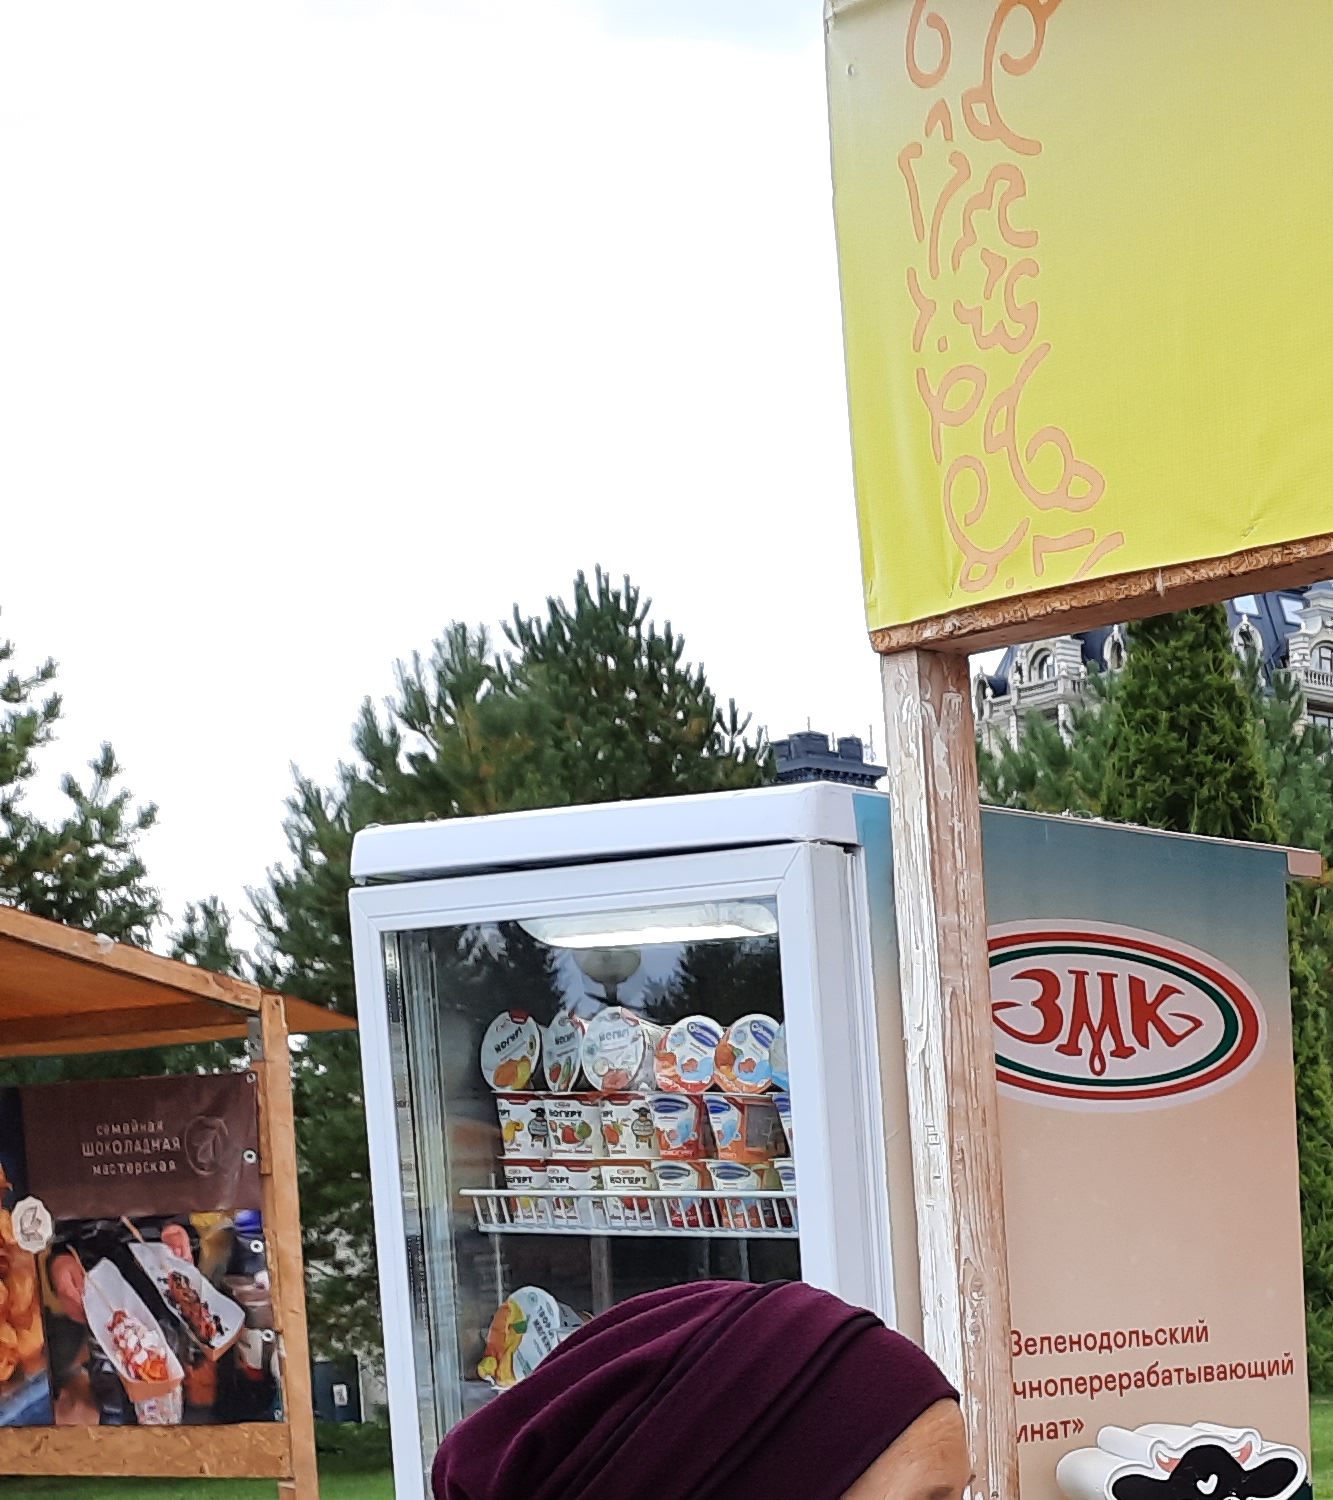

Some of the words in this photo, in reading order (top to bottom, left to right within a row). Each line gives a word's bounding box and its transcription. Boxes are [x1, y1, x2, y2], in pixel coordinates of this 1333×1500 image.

[992, 967, 1204, 1076] ЗМК
[81, 1136, 181, 1157] ШОКОЛАДНАЯ
[1010, 1317, 1209, 1357] Зеленодольский
[1013, 1351, 1294, 1400] чноперерабатывающий
[1016, 1417, 1085, 1444] инат»
